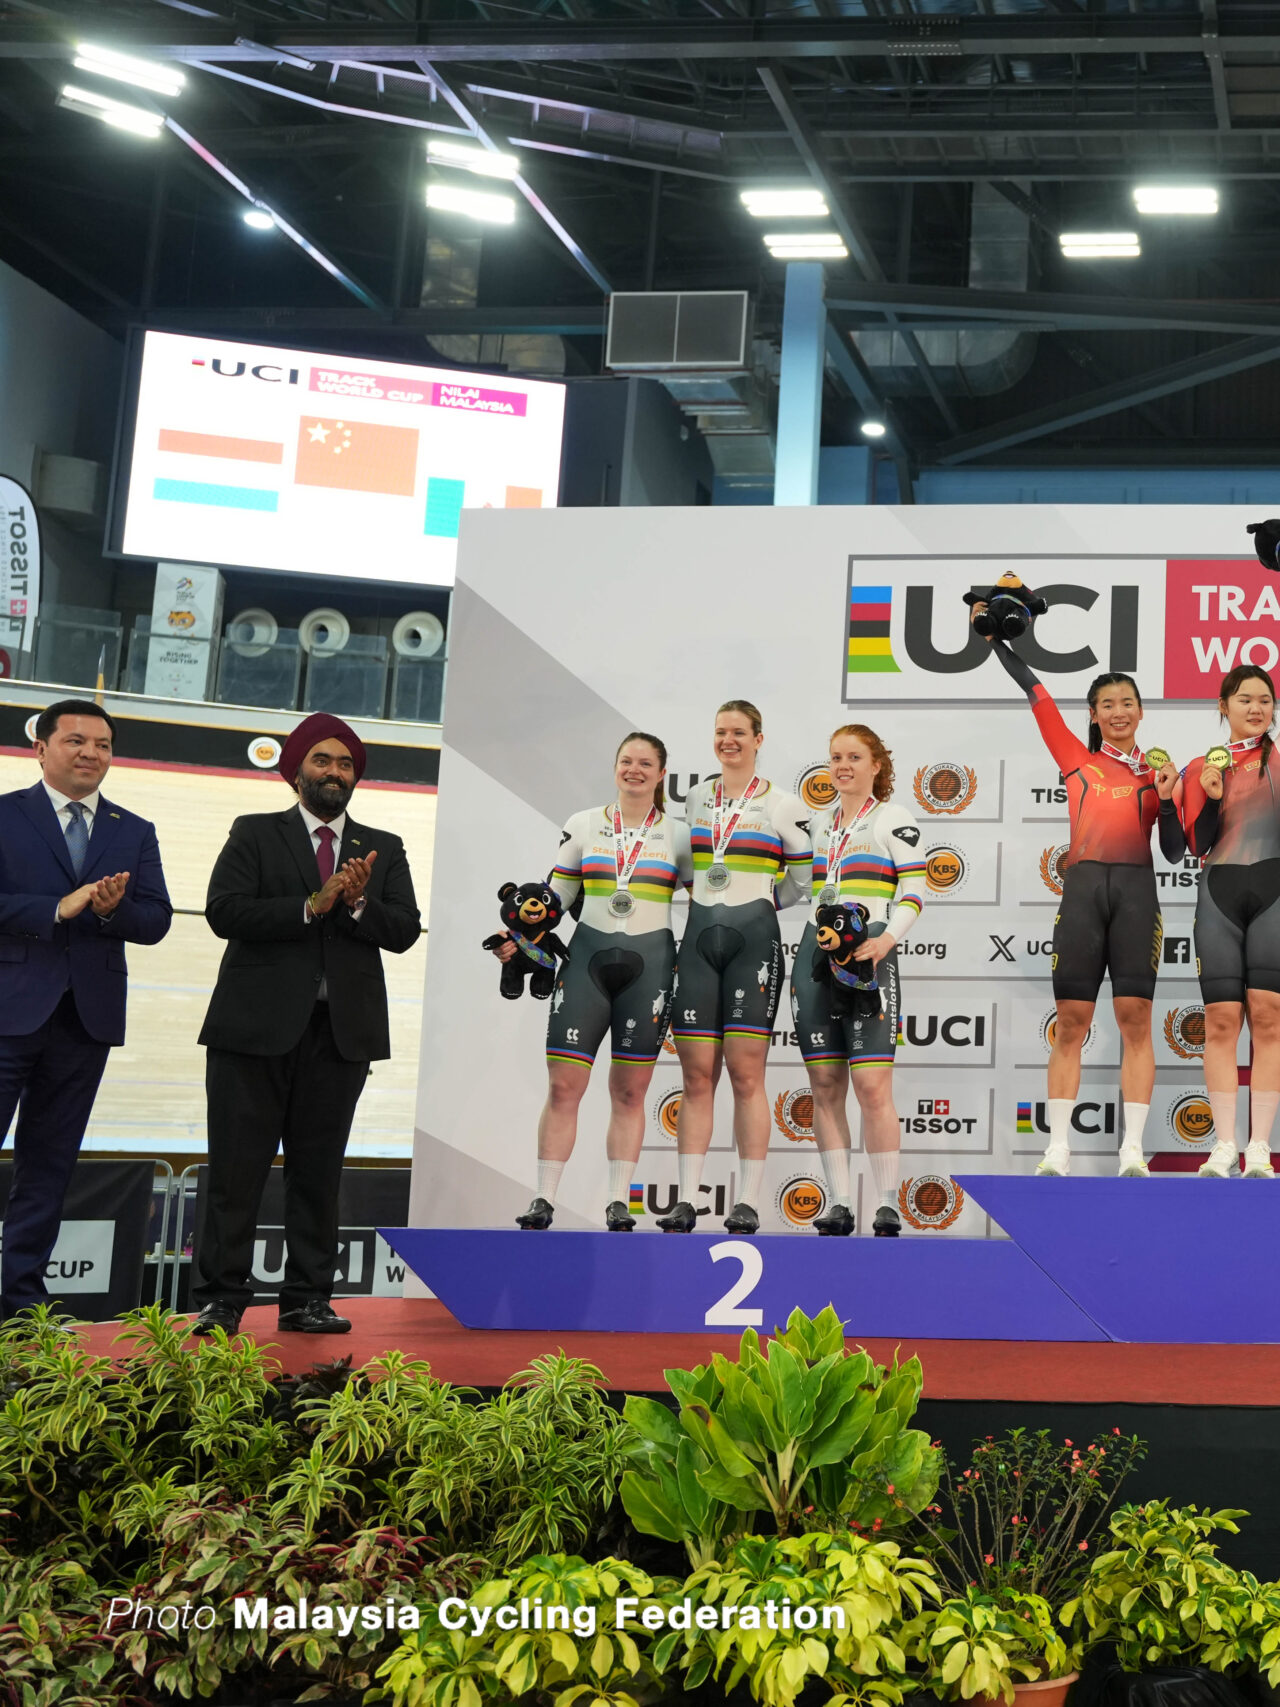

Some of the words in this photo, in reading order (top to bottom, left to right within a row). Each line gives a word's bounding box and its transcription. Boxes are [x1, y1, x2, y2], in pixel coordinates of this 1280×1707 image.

[211, 358, 299, 385] UCI
[318, 371, 376, 388] TRACK
[317, 381, 384, 400] WORLD
[387, 389, 424, 403] CUP
[440, 386, 480, 399] NILAI
[438, 396, 515, 414] MALAYSIA
[903, 584, 1139, 674] UCI
[1152, 755, 1164, 763] UCI
[812, 783, 836, 793] KBS
[1031, 788, 1068, 804] TIS
[933, 865, 957, 875] KBS
[1156, 872, 1201, 888] TISS
[1027, 941, 1052, 956] UC
[766, 939, 780, 1019] Staatsloterij
[886, 962, 897, 1046] Staatsloterij
[907, 1015, 985, 1047] UCI
[1187, 1113, 1210, 1125] KBS
[647, 1184, 725, 1217] UCI
[795, 1196, 818, 1207] KBS
[43, 1260, 95, 1279] CUP
[704, 1241, 763, 1326] 2
